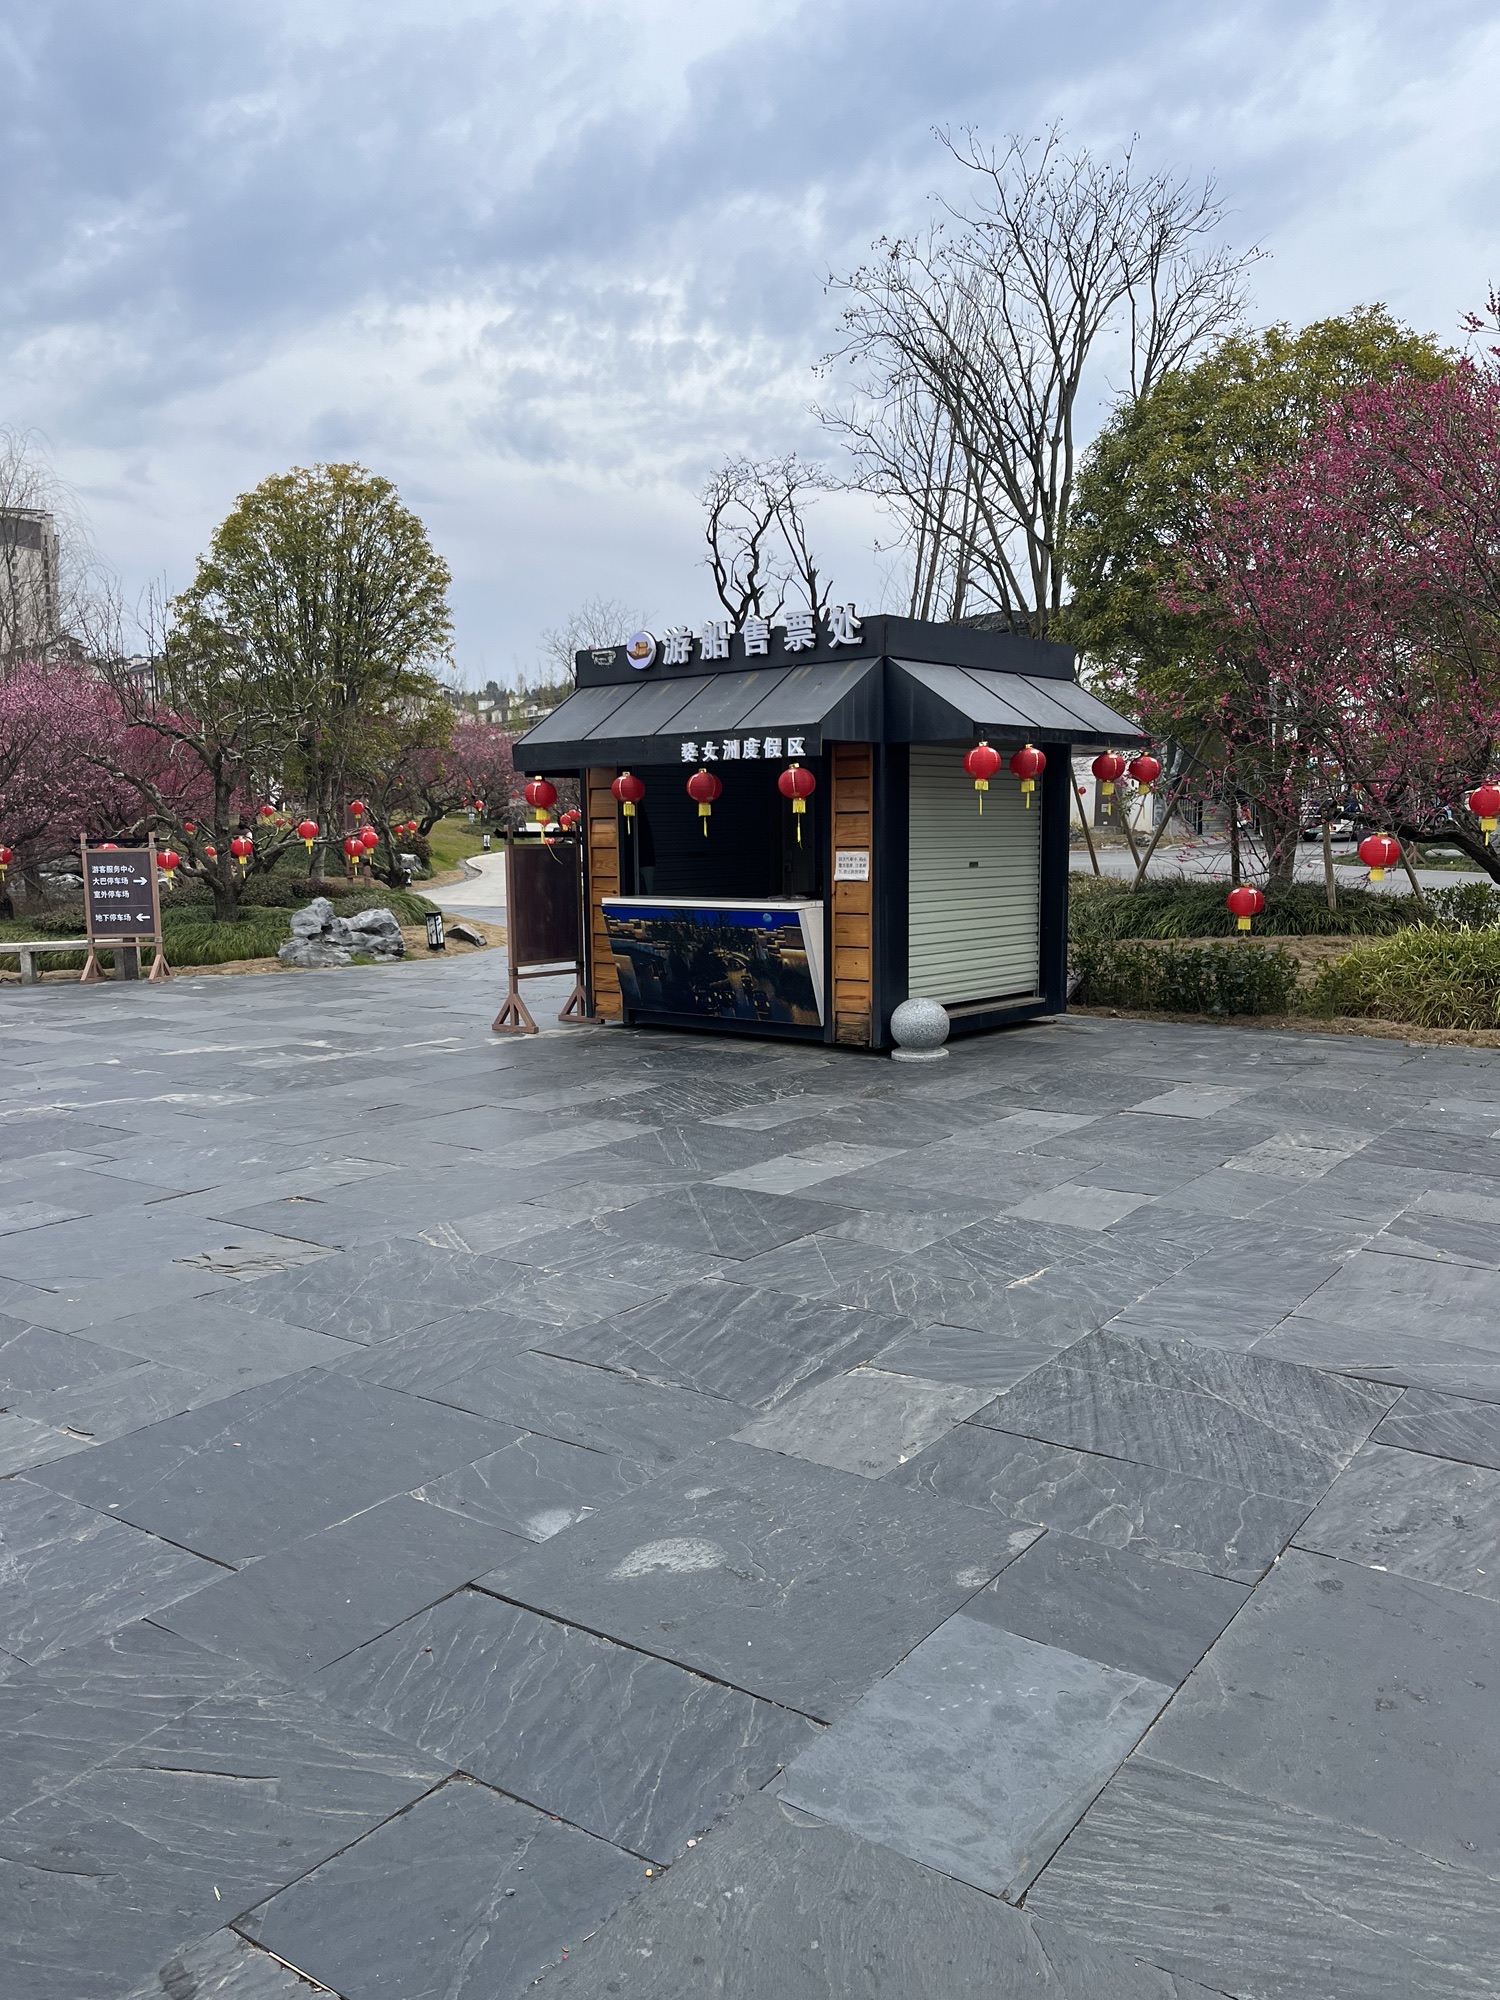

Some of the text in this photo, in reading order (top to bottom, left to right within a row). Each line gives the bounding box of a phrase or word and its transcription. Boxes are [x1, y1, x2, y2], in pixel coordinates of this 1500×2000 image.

[662, 603, 863, 666] 游船售票处
[681, 736, 806, 763] 婺女洲度假区
[92, 865, 135, 873] 游客服务中心
[92, 877, 129, 885] 大巴停车场
[93, 890, 129, 898] 室外停车场
[95, 913, 131, 922] 地下停车场
